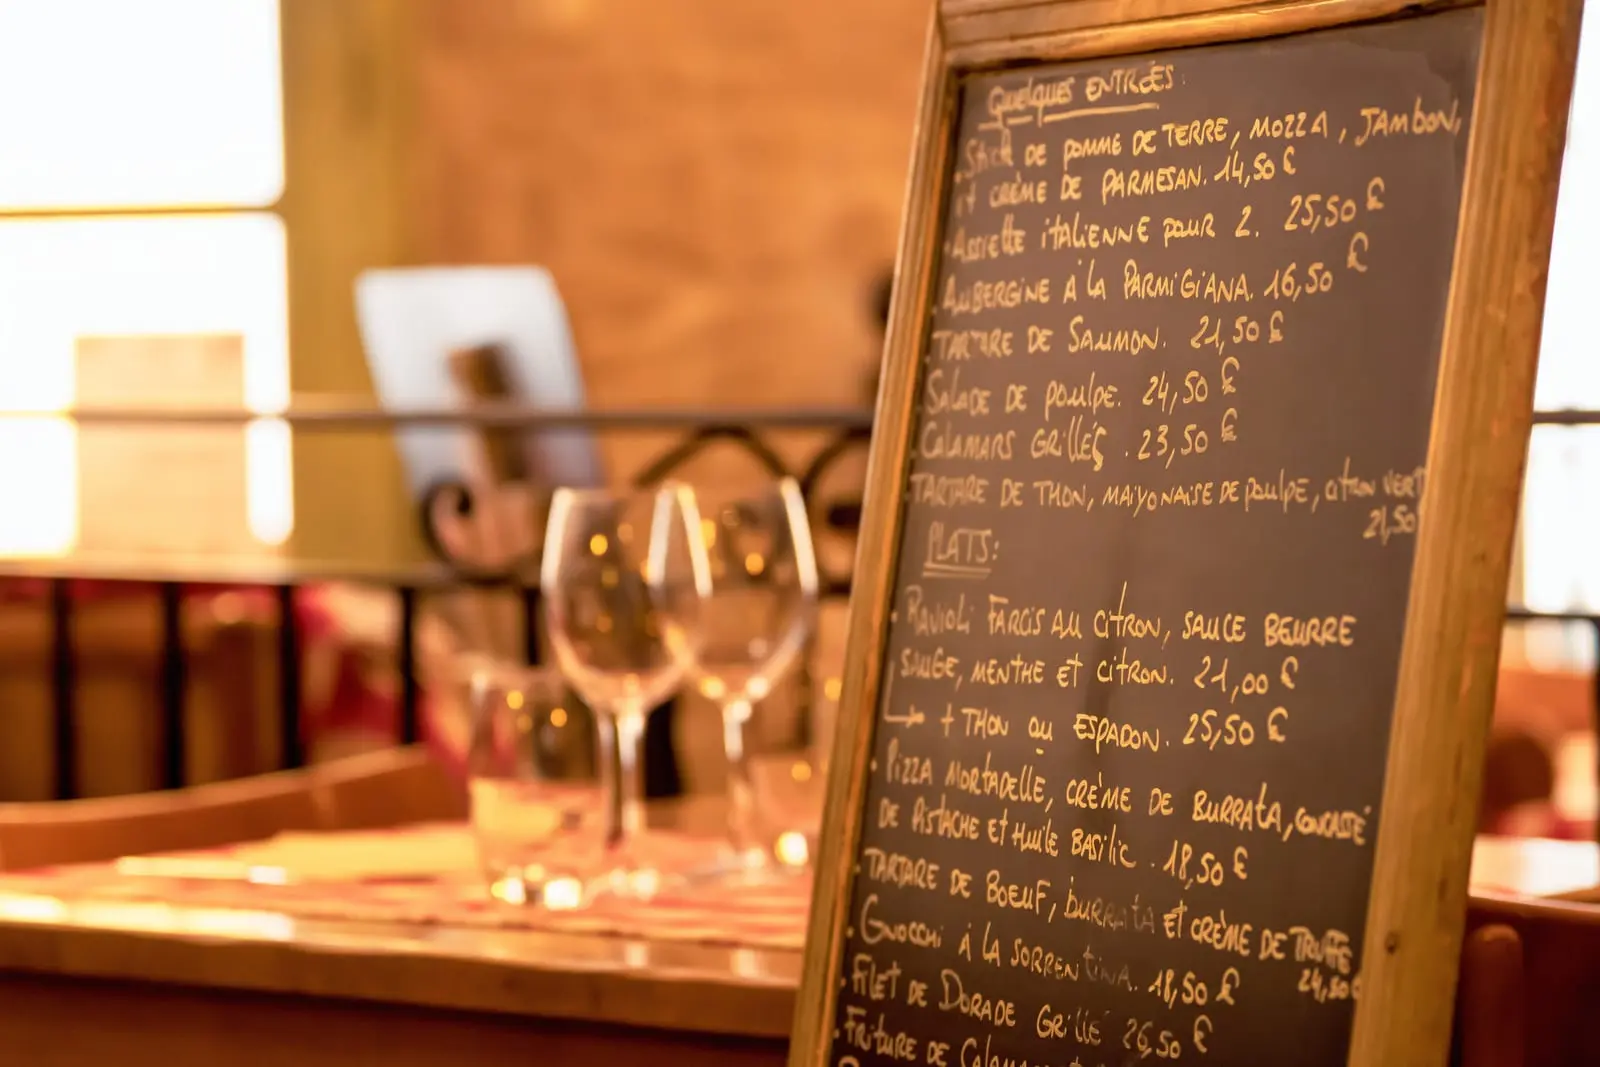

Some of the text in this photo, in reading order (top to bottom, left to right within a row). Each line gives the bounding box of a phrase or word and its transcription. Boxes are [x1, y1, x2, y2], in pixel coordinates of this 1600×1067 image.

[1024, 143, 1048, 167] DE
[1132, 129, 1158, 156] DE
[1161, 117, 1240, 150] TERRE,
[1060, 173, 1083, 201] DE
[1101, 165, 1207, 206] PARMESAN.
[1213, 150, 1275, 189] 14,50
[1283, 193, 1357, 234] 25,50
[1263, 261, 1333, 303] 16,50
[1027, 325, 1053, 355] DE
[1189, 315, 1260, 356] 21,50
[1004, 383, 1028, 414] DE
[1141, 369, 1209, 416] 24,50
[909, 472, 990, 507] TARTARE
[1000, 478, 1024, 509] DE
[1032, 478, 1095, 513] THON,
[1218, 480, 1240, 505] DE
[1050, 608, 1083, 640] AU
[1182, 610, 1246, 643] SAUCE
[1264, 611, 1357, 648] BEURRE
[1193, 655, 1269, 704] 21,00
[960, 707, 1009, 740] THON
[1072, 712, 1170, 755] ESPADON.
[1182, 709, 1255, 752] 25,50
[1148, 787, 1174, 816] DE
[878, 797, 901, 829] DE
[1162, 839, 1224, 890] 18,50
[863, 847, 940, 890] TARTARE
[949, 868, 973, 899] DE
[1258, 928, 1288, 961] DE
[1148, 967, 1208, 1010] 18,50
[907, 979, 928, 1008] DE
[938, 968, 1016, 1028] DORADE
[1121, 1018, 1182, 1060] 26,50
